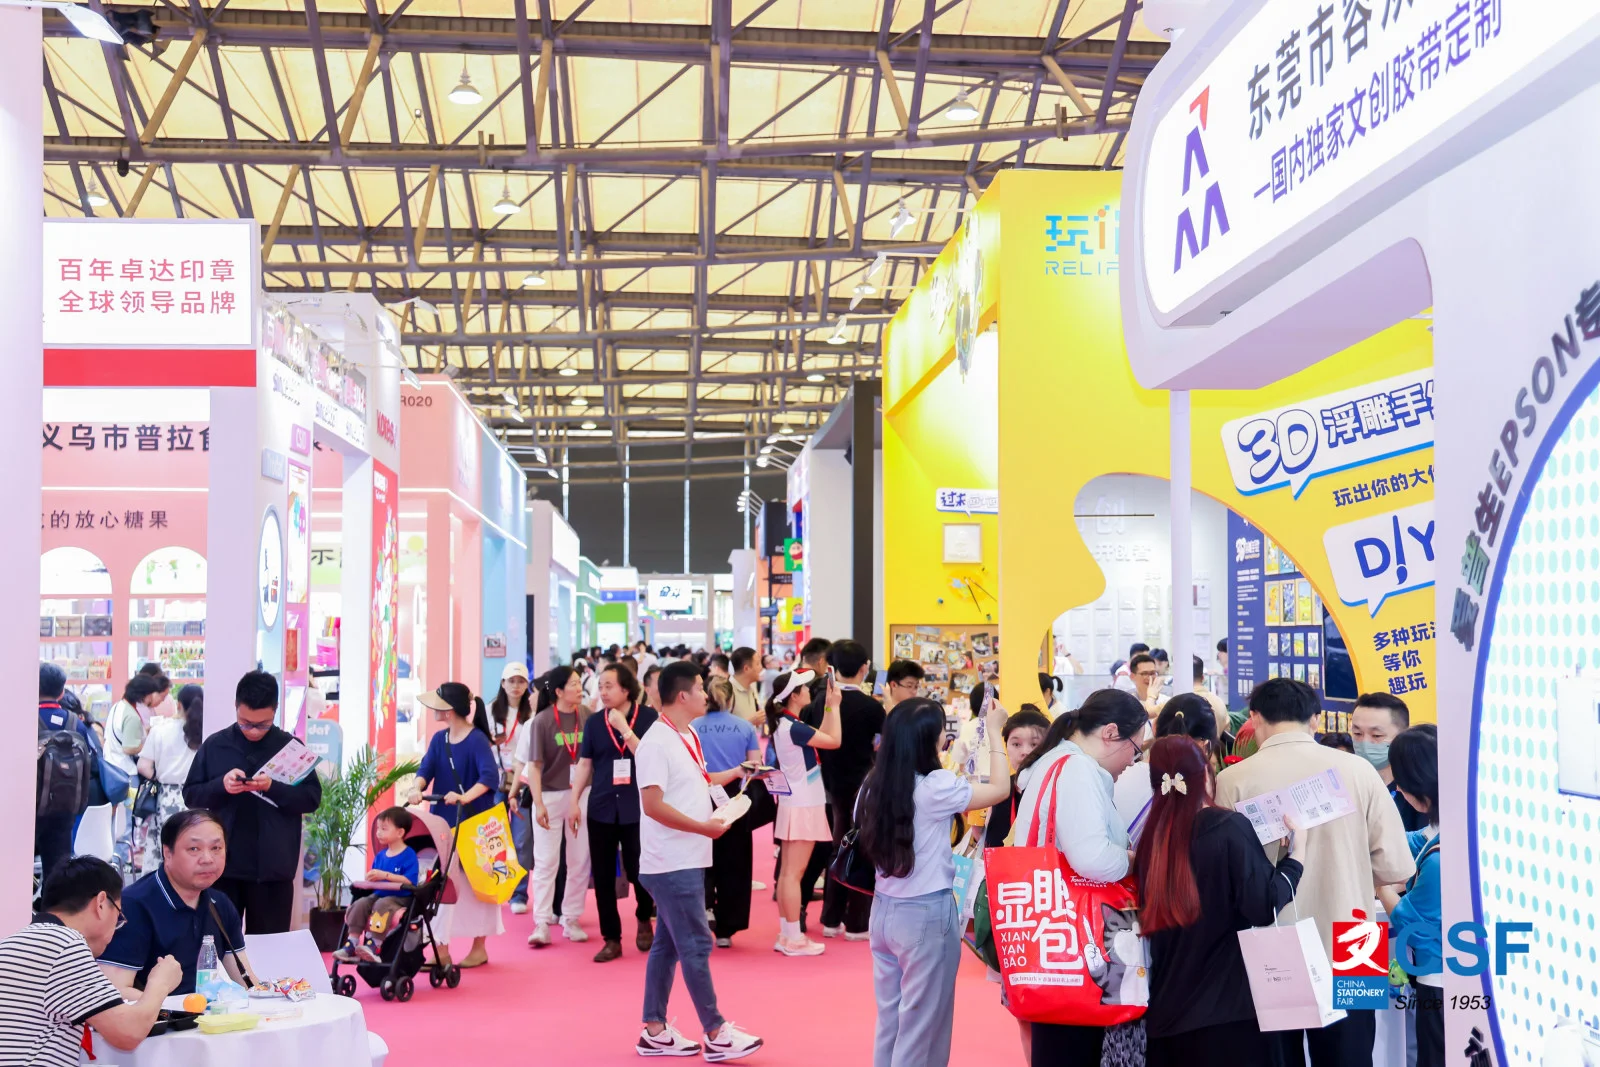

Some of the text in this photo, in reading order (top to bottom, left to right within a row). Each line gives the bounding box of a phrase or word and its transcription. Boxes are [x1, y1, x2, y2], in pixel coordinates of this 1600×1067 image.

[58, 259, 236, 282] 百年卓达印章
[58, 290, 236, 314] 全球领导品牌
[41, 509, 169, 530] 的放心糖果
[1383, 650, 1423, 672] 等你
[1388, 672, 1428, 696] 趣玩
[1000, 930, 1031, 943] XIAN
[1001, 943, 1025, 955] YAN
[1003, 955, 1027, 969] BAO
